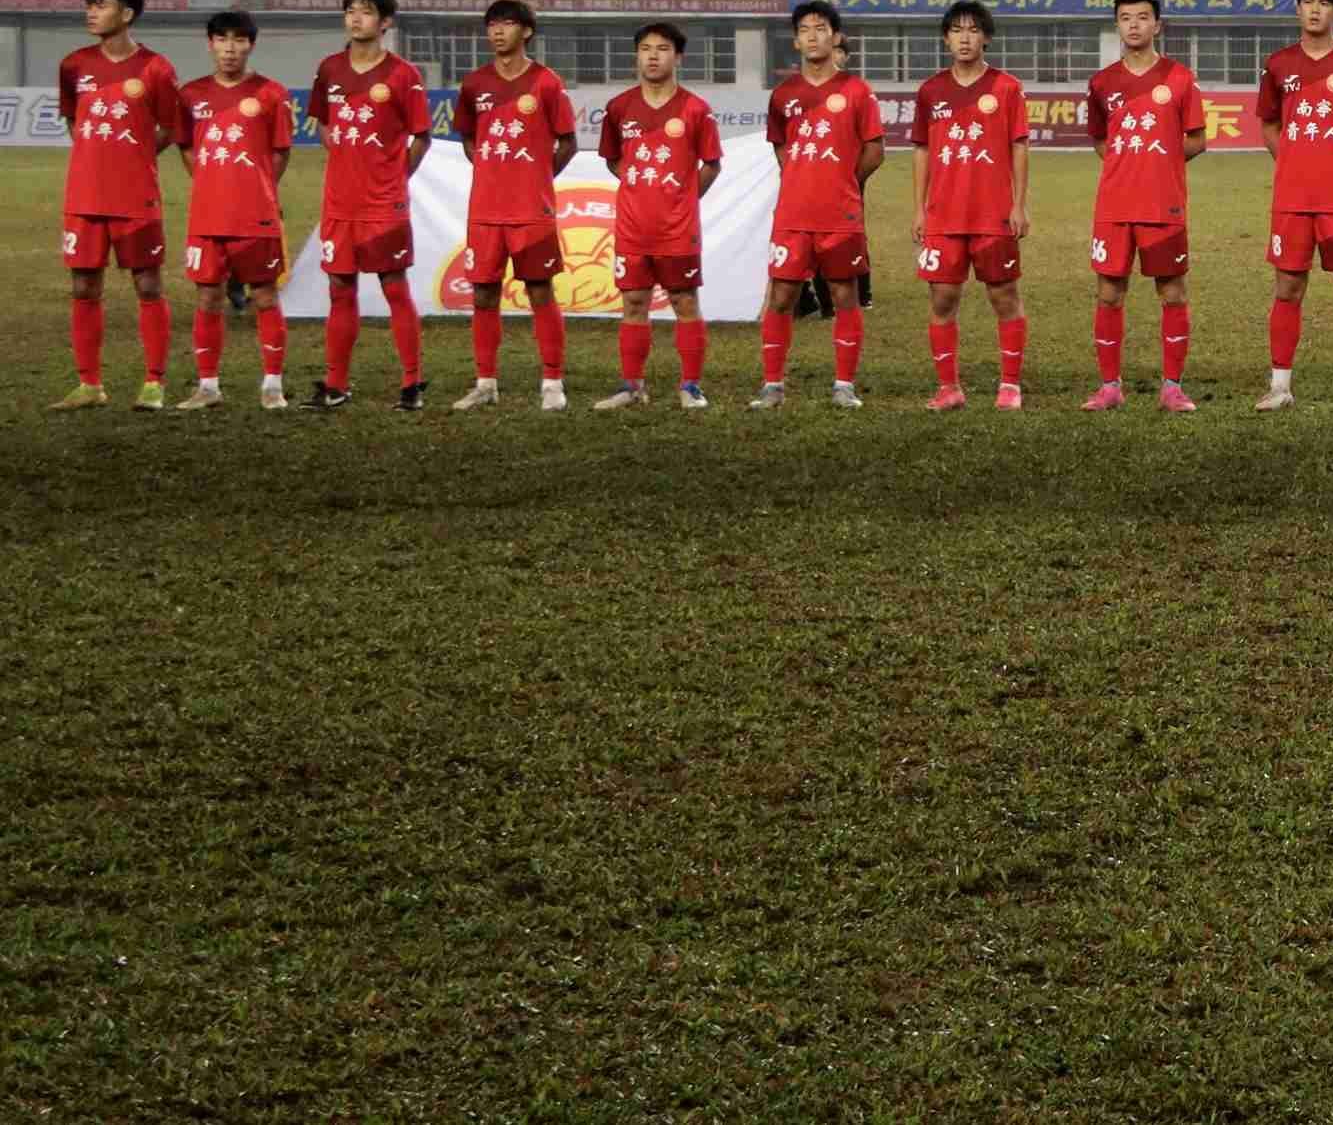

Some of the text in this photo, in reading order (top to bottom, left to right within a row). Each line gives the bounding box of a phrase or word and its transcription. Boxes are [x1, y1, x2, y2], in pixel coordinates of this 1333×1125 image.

[80, 121, 136, 143] 青年人
[331, 126, 382, 147] 青年人
[480, 141, 533, 161] 青年人
[789, 142, 840, 161] 青年人
[1112, 135, 1166, 154] 青年人
[199, 147, 254, 165] 青年人
[938, 146, 993, 165] 青年人
[627, 165, 680, 186] 青年人
